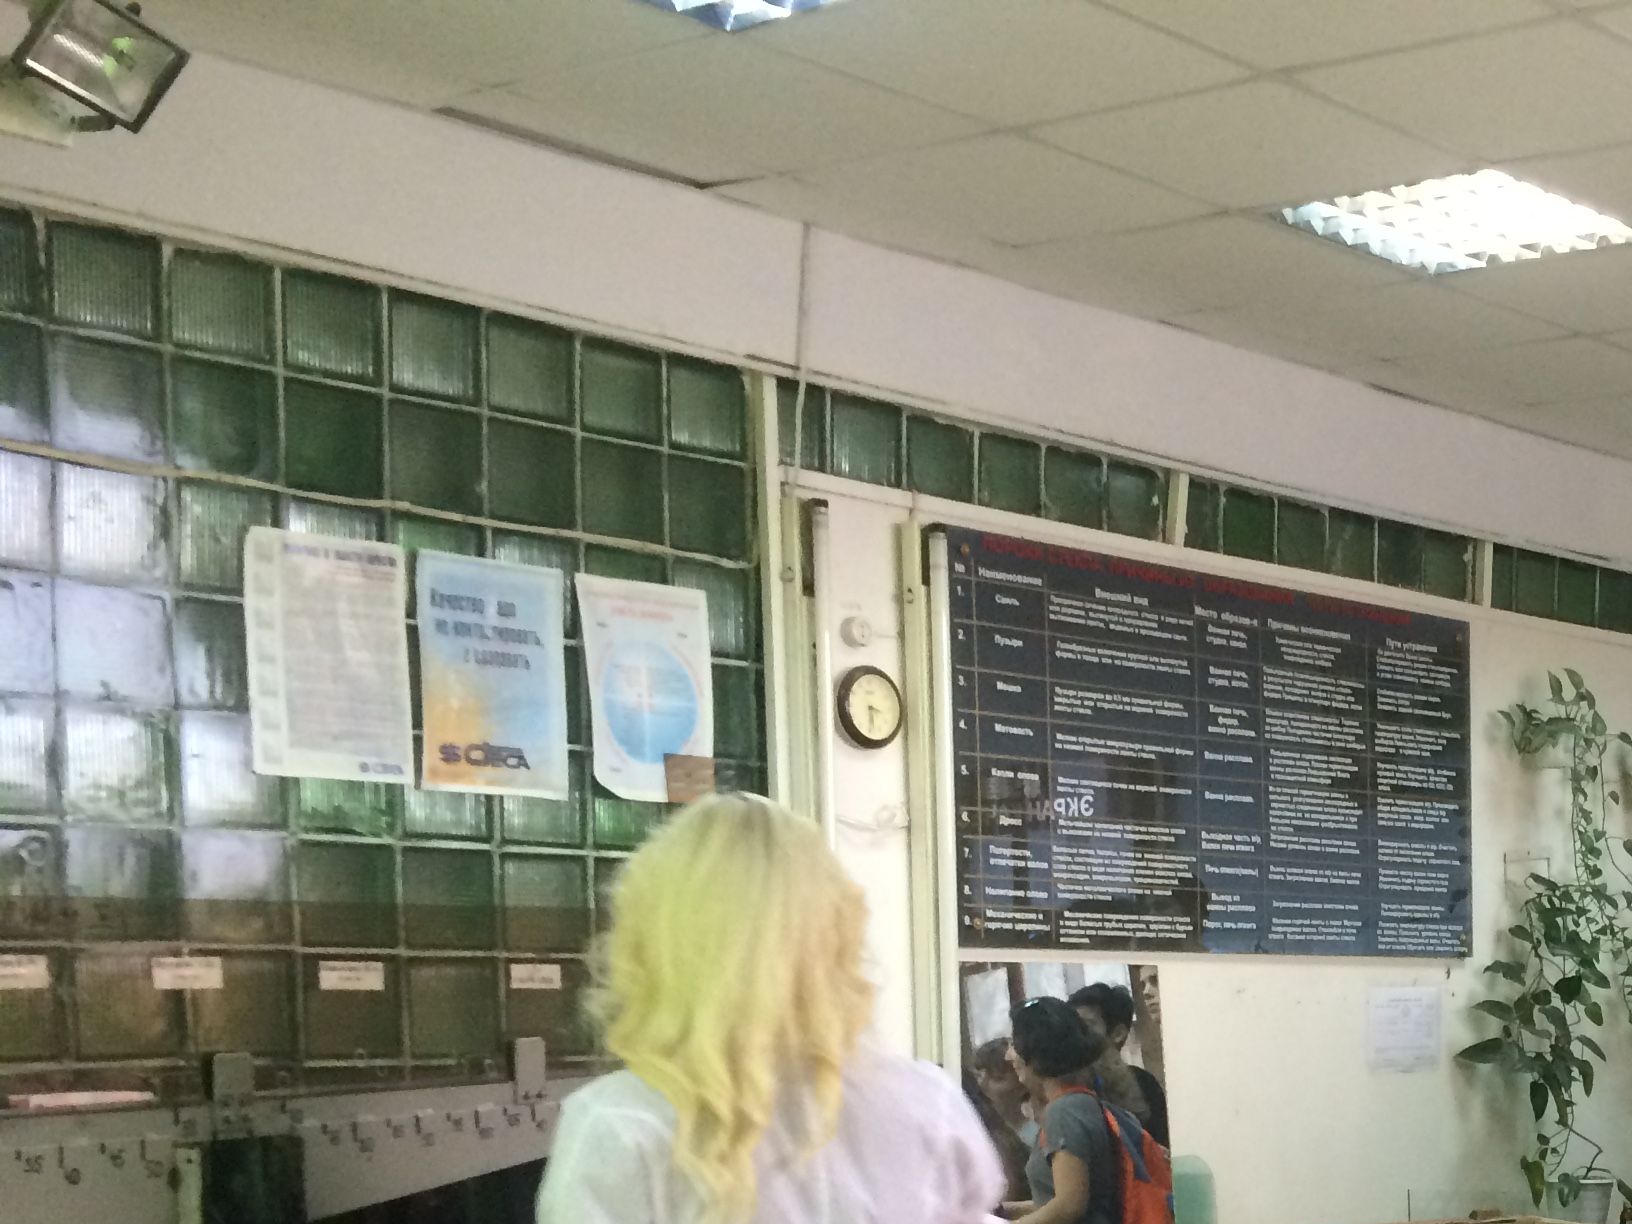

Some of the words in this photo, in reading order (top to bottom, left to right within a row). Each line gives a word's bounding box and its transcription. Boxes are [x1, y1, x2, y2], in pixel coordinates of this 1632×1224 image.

[978, 567, 1042, 586] Наименование
[430, 588, 484, 615] Качество
[1195, 604, 1217, 619] Место
[958, 629, 966, 640] 2.
[958, 675, 966, 686] 3.
[959, 719, 967, 729] 4.
[961, 764, 969, 775] 5.
[964, 848, 972, 858] 7.
